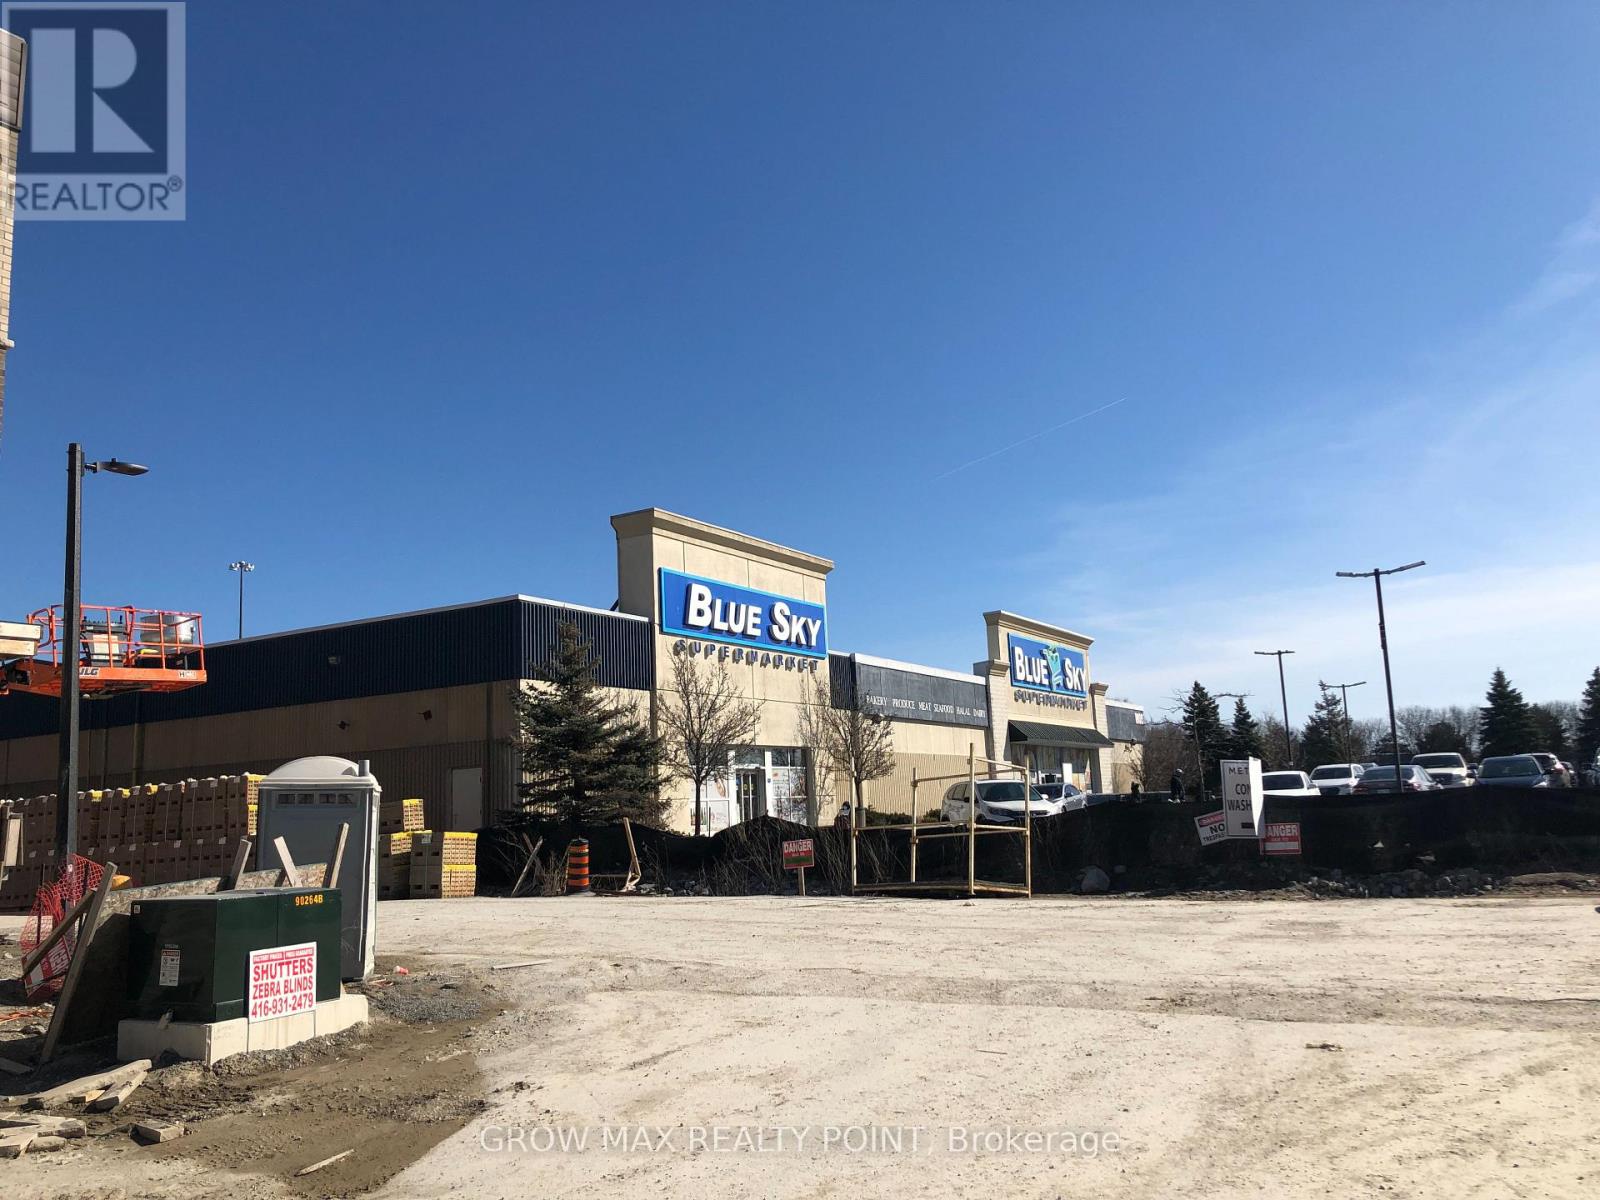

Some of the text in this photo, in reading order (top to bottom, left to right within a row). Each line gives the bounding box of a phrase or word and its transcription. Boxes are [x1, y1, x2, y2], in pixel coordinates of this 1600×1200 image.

[686, 583, 821, 647] BLUE SKY
[674, 639, 819, 673] SUPERMARKET
[1014, 646, 1087, 691] BLUE SKY
[1209, 823, 1225, 834] NO
[1266, 824, 1298, 837] ANGER
[784, 840, 812, 853] DANGER
[253, 957, 314, 982] SHUTTERS
[252, 975, 313, 1000] ZEBRA BLINDS
[251, 993, 314, 1018] 416-931-2479
